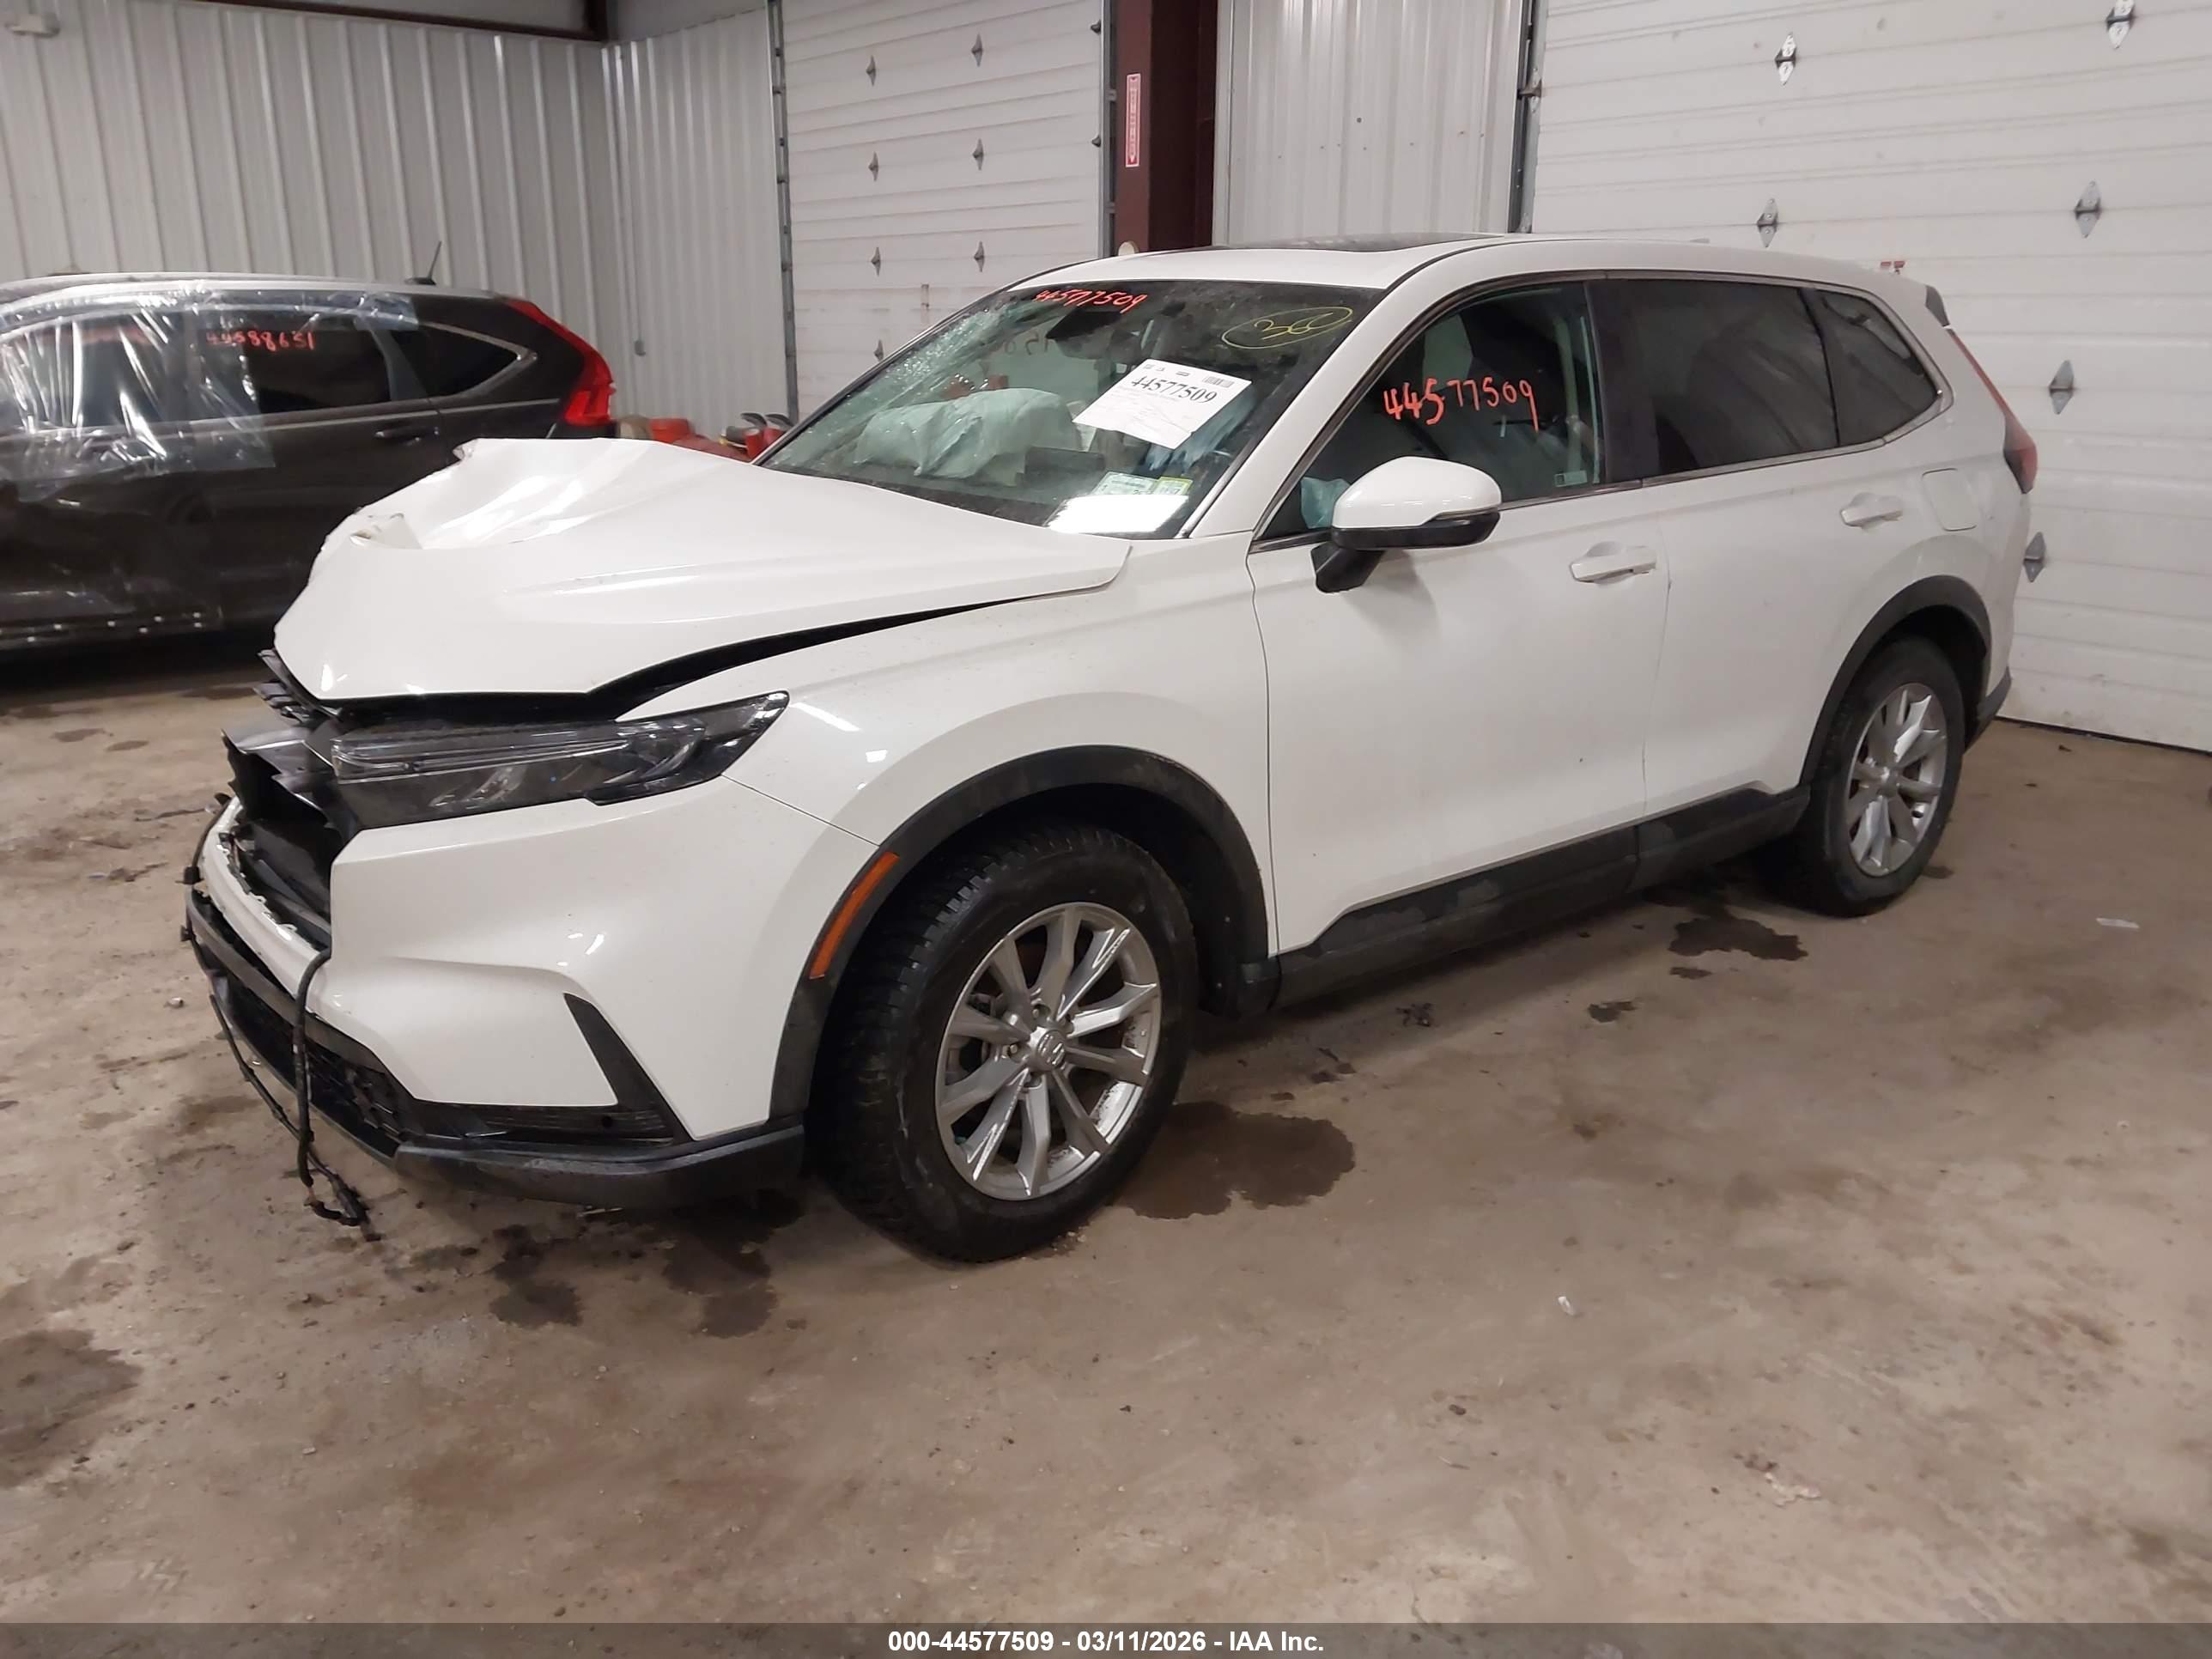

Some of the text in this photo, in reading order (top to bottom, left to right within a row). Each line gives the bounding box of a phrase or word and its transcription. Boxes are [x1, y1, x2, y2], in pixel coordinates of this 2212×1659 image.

[1033, 289, 1147, 313] 44577509
[1131, 375, 1218, 404] 44577509
[1383, 376, 1540, 433] 44577509
